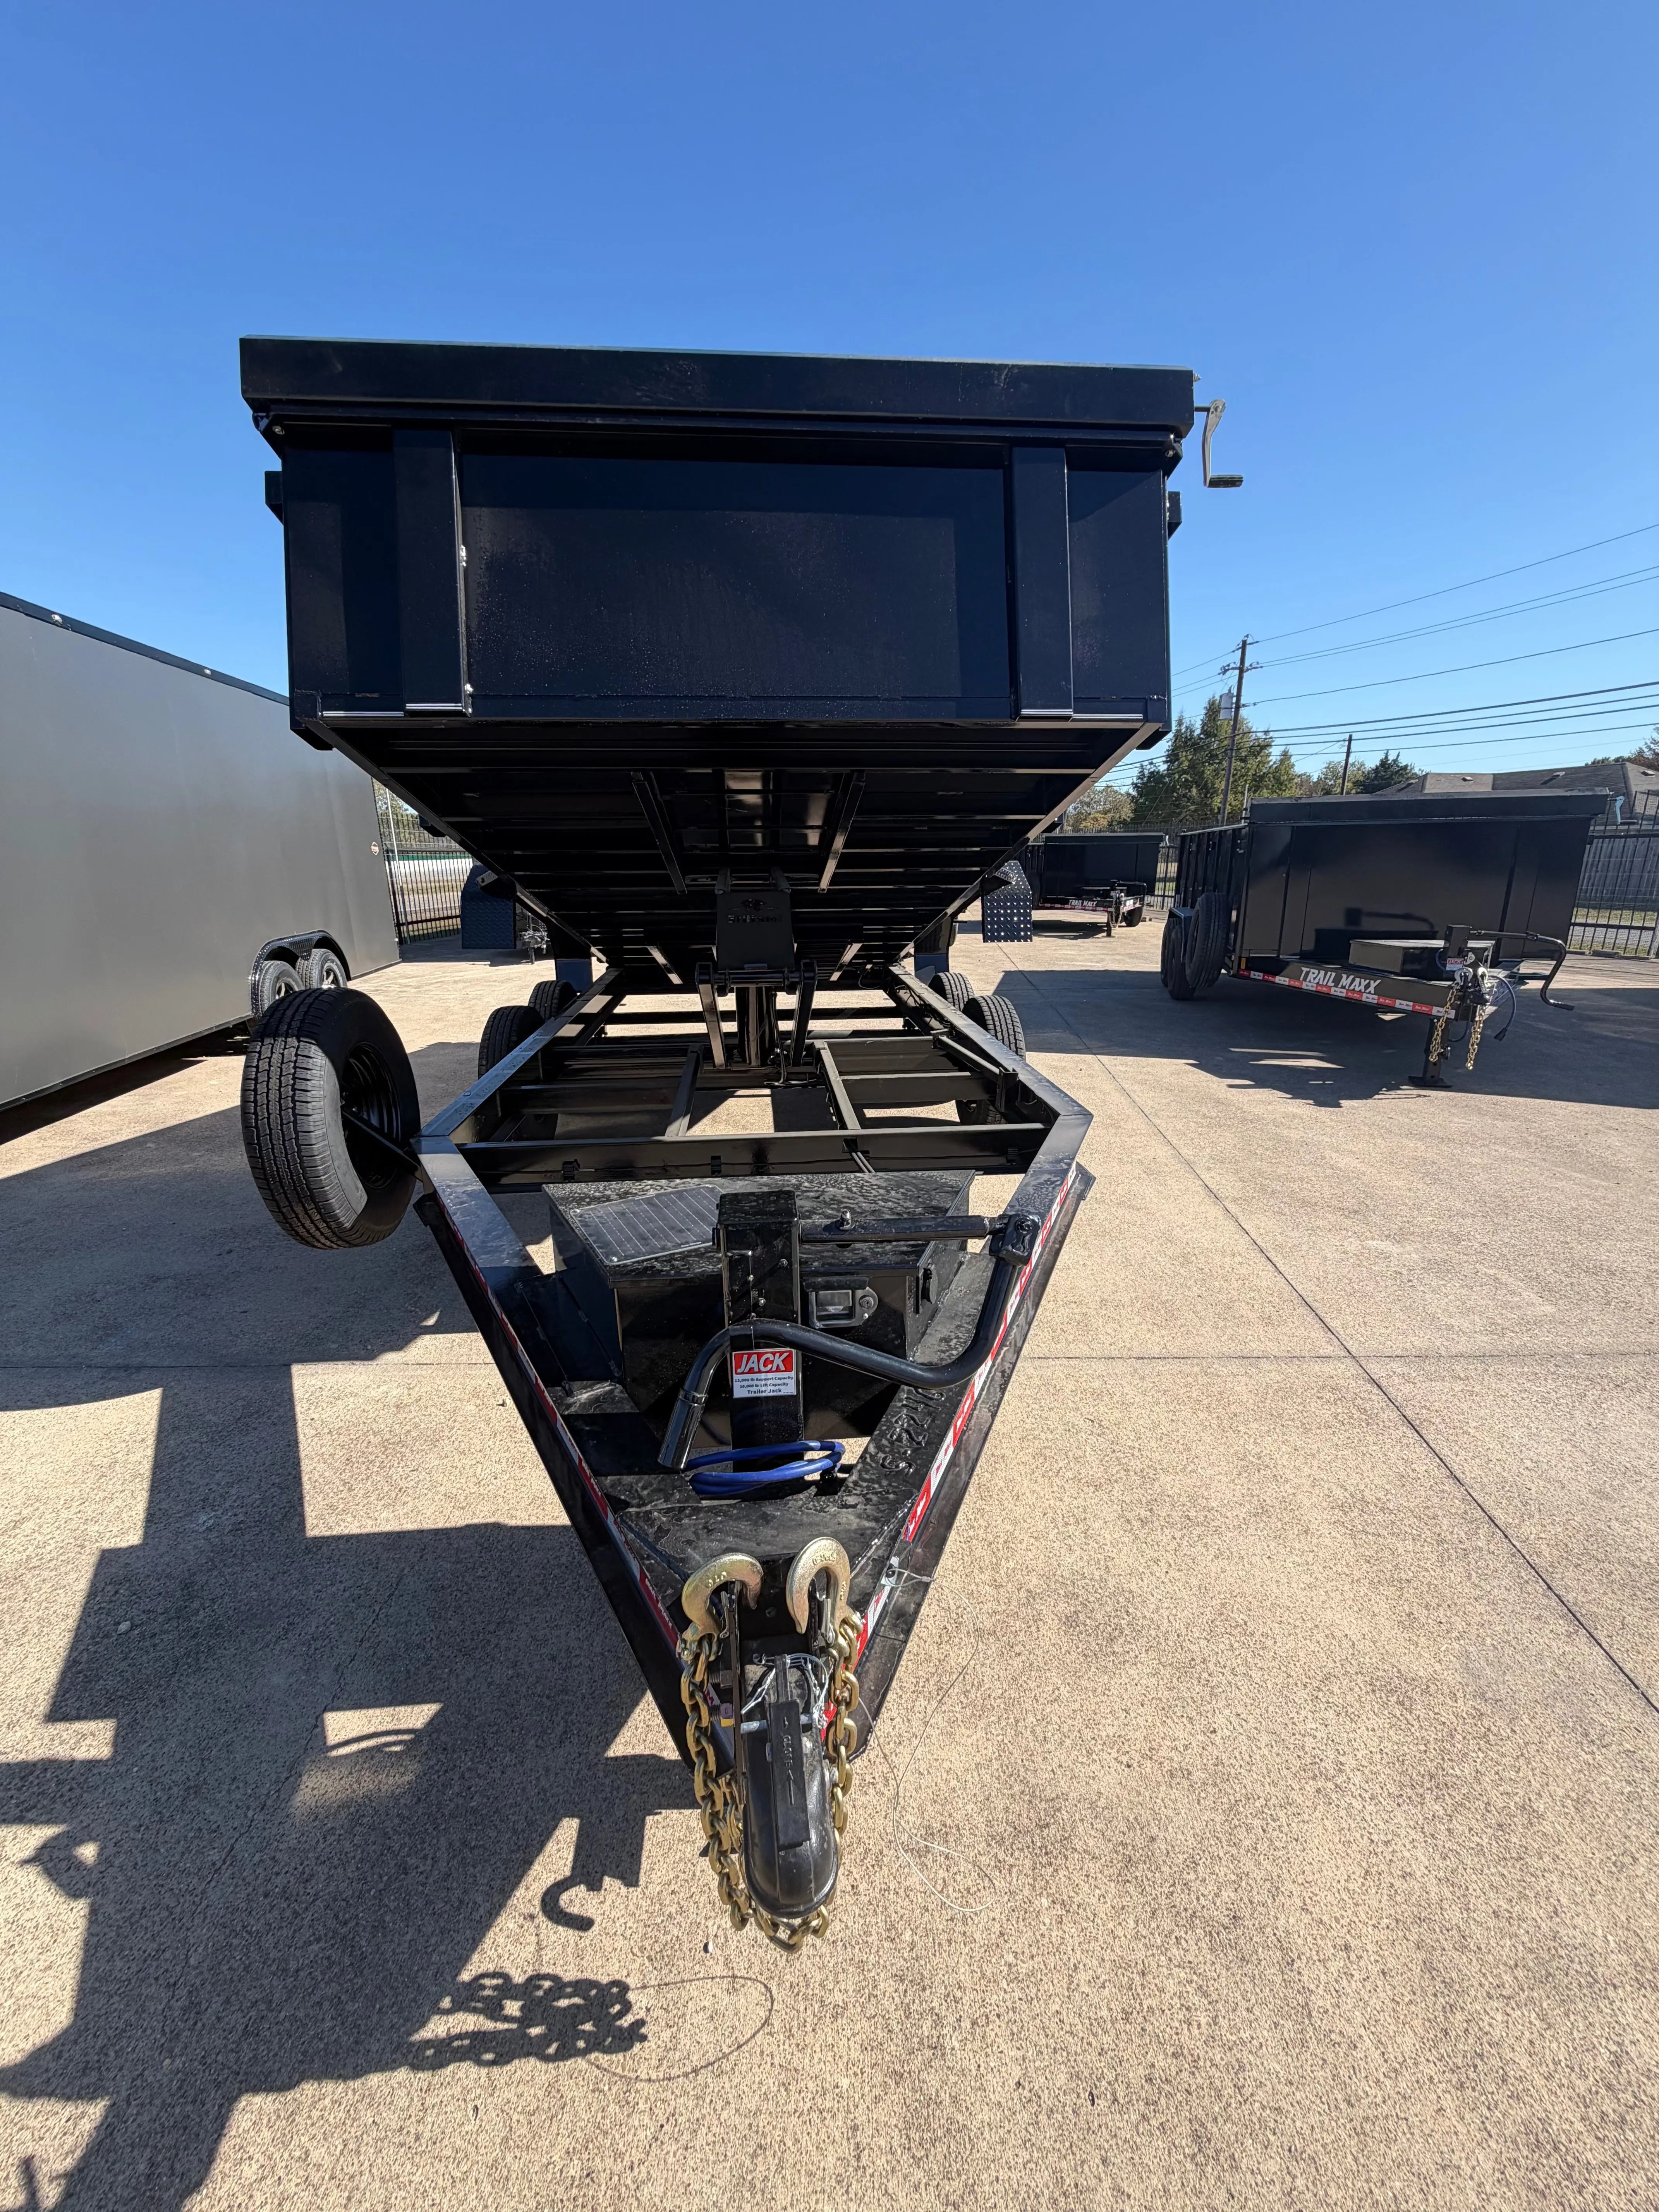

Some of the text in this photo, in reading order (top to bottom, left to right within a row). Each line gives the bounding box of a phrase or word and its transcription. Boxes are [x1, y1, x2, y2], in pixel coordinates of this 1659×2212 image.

[1300, 967, 1382, 994] TRAIL MAXX
[737, 1352, 790, 1373] JACK
